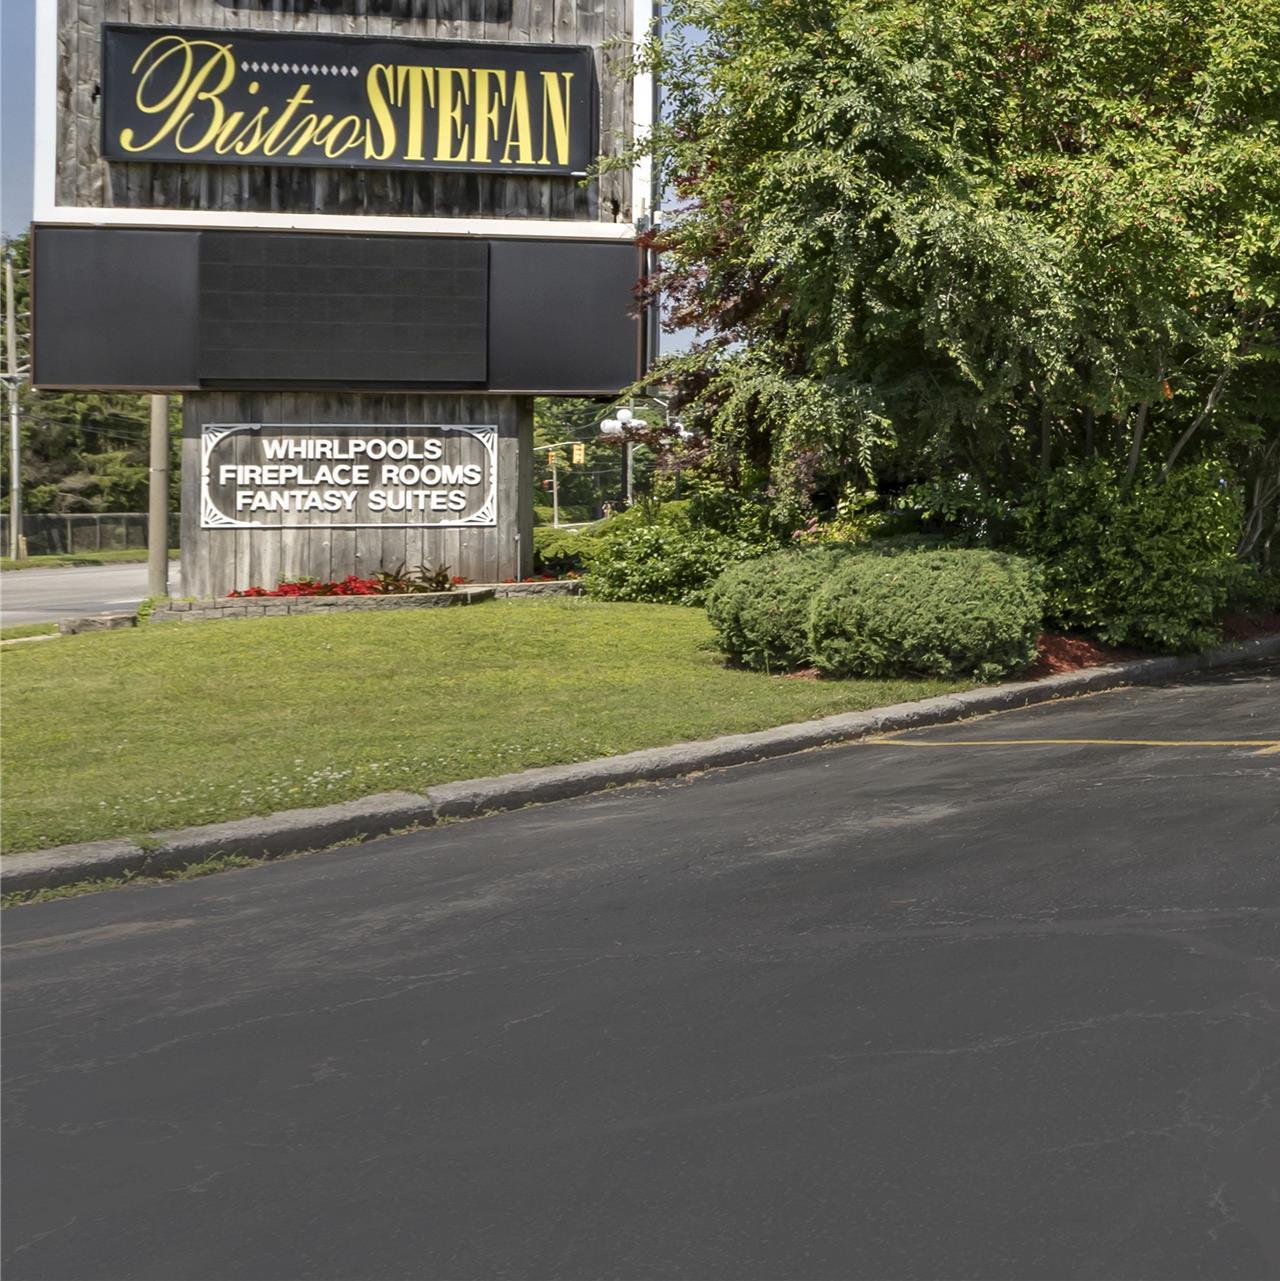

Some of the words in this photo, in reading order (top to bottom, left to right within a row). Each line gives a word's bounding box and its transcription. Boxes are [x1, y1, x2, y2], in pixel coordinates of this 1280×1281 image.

[262, 438, 443, 460] WHIRLPOOLS
[218, 464, 370, 486] FIREPLACE
[381, 464, 482, 486] ROOMS
[235, 490, 358, 512] FANTASY
[367, 490, 467, 511] SUITES
